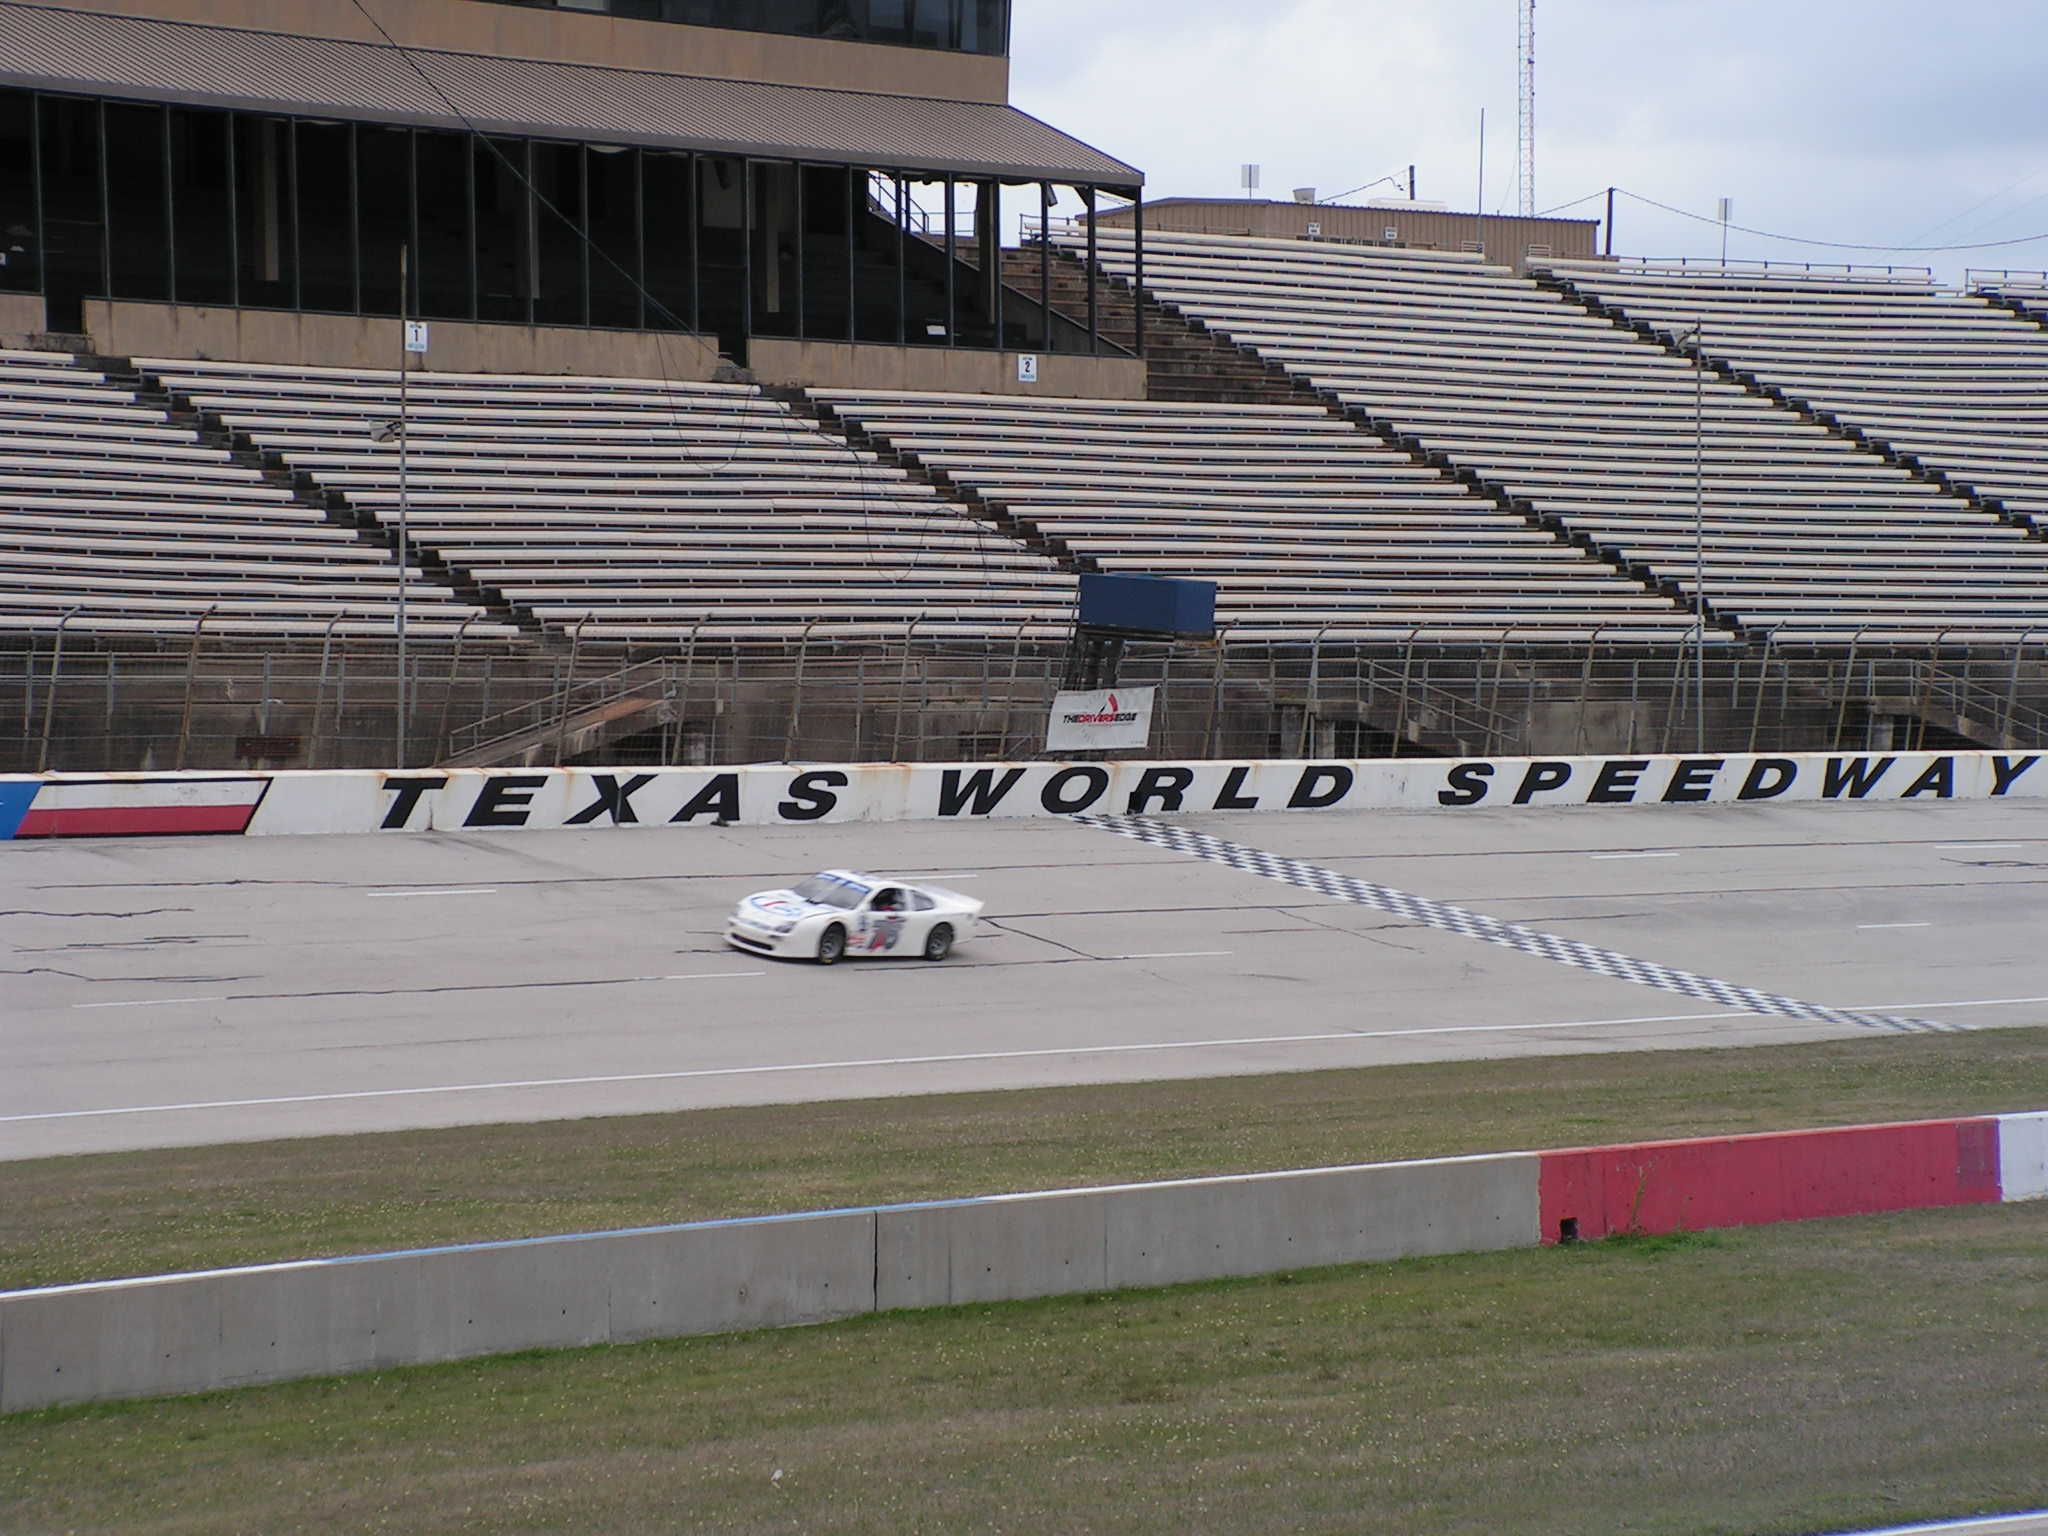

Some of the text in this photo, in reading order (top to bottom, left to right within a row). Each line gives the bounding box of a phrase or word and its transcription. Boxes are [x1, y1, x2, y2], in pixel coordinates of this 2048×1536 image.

[381, 756, 2041, 829] TEXAS WORLD SPEEDWAY
